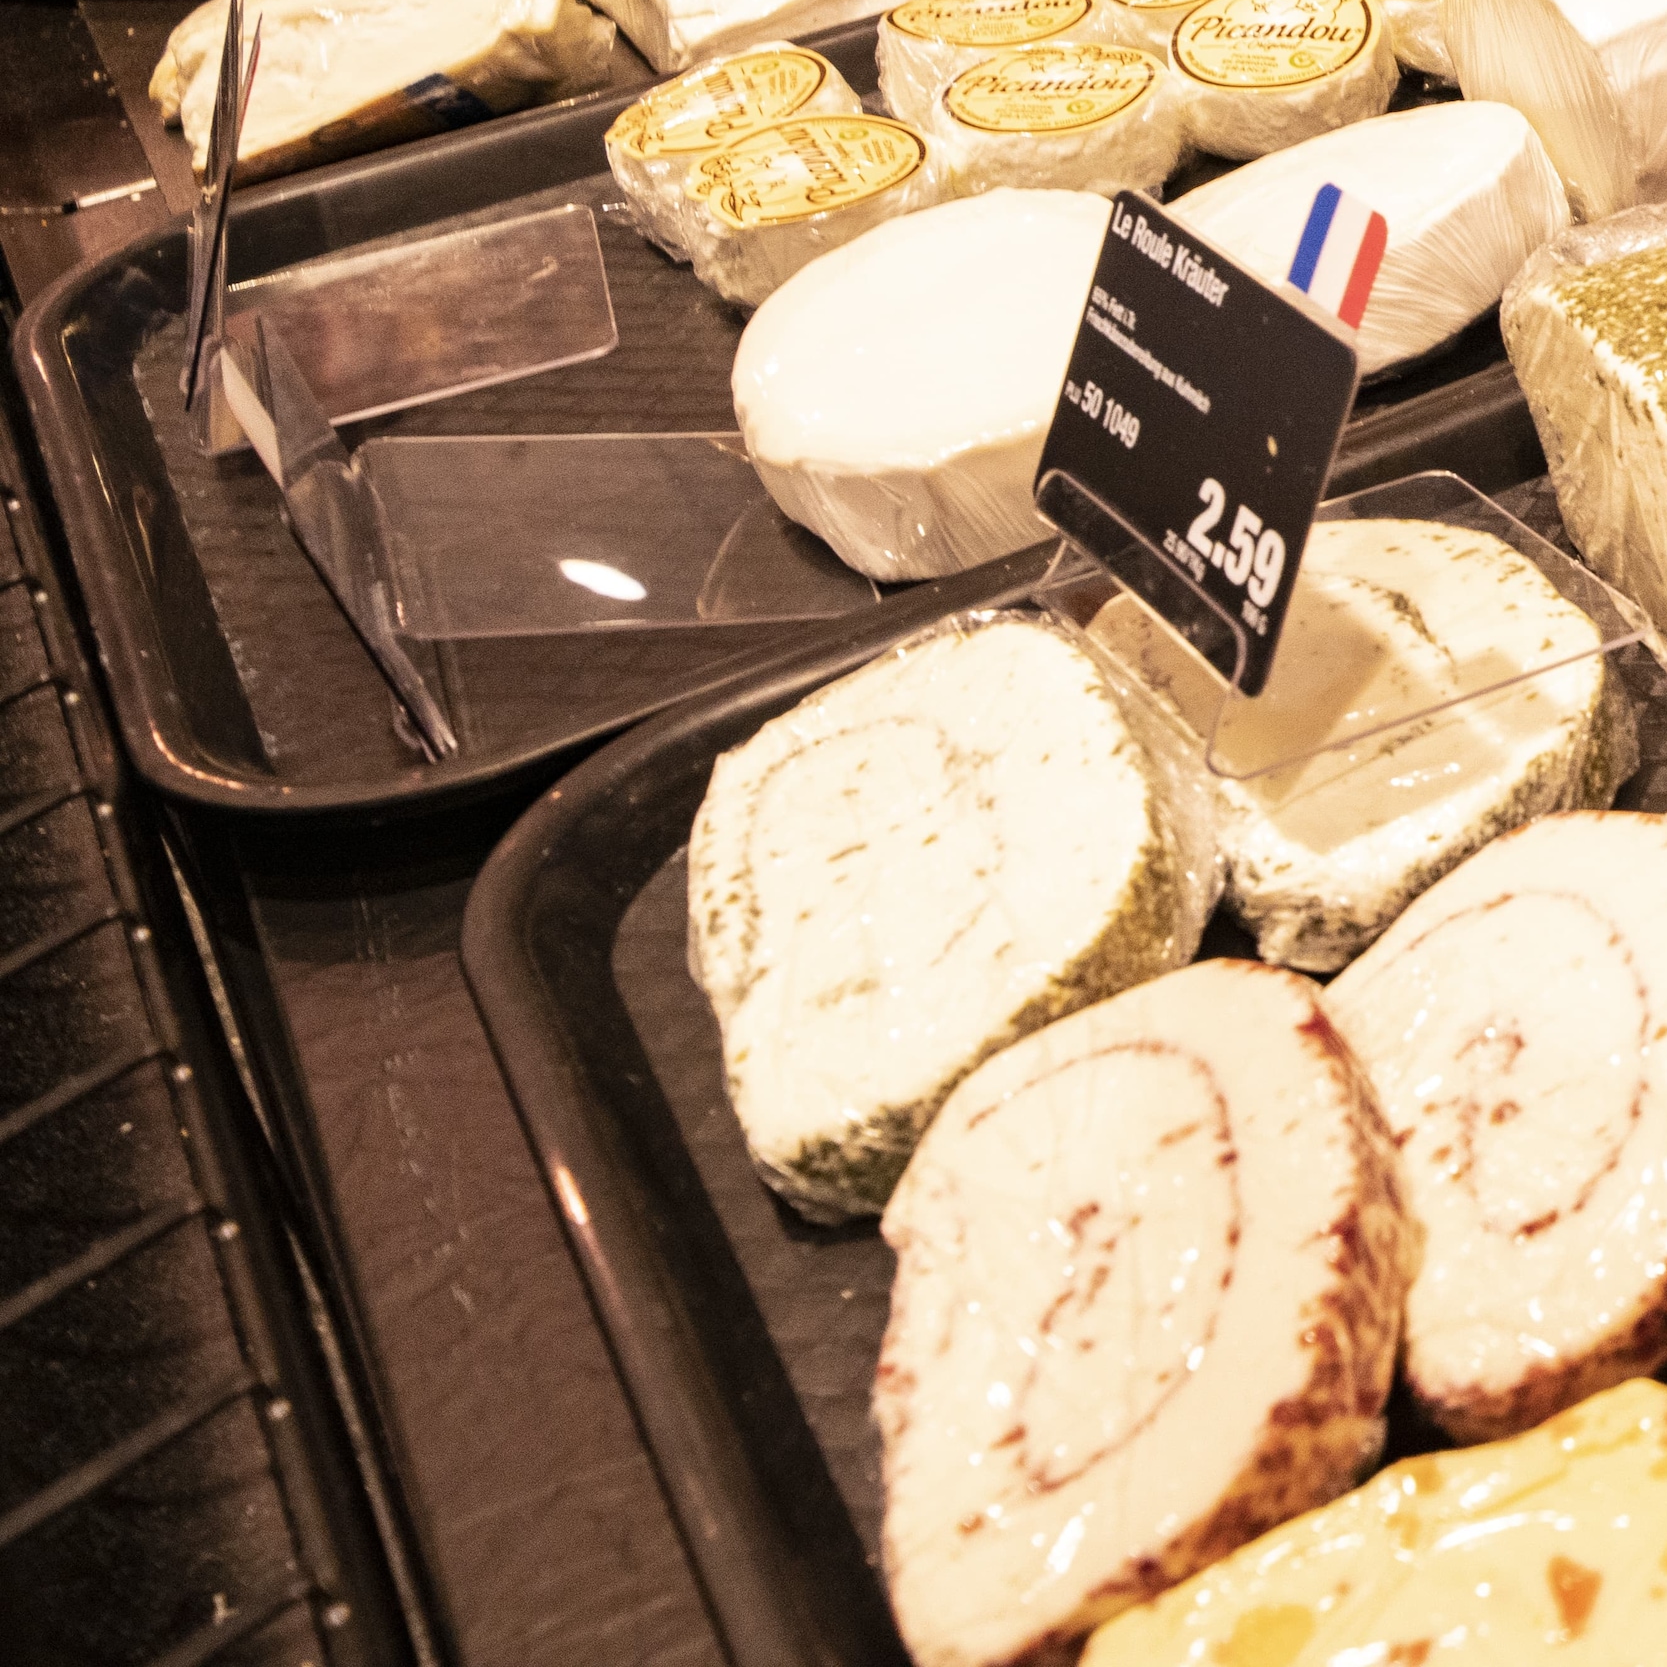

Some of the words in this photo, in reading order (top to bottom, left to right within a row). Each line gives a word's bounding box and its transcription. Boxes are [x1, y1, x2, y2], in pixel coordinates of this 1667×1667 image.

[1192, 14, 1355, 42] Picandou
[1112, 201, 1132, 240] Le
[1131, 214, 1174, 269] Roule
[1172, 243, 1229, 308] Kräuter
[1081, 380, 1104, 420] 50
[1103, 397, 1141, 450] 1049
[1185, 477, 1285, 610] 2.59
